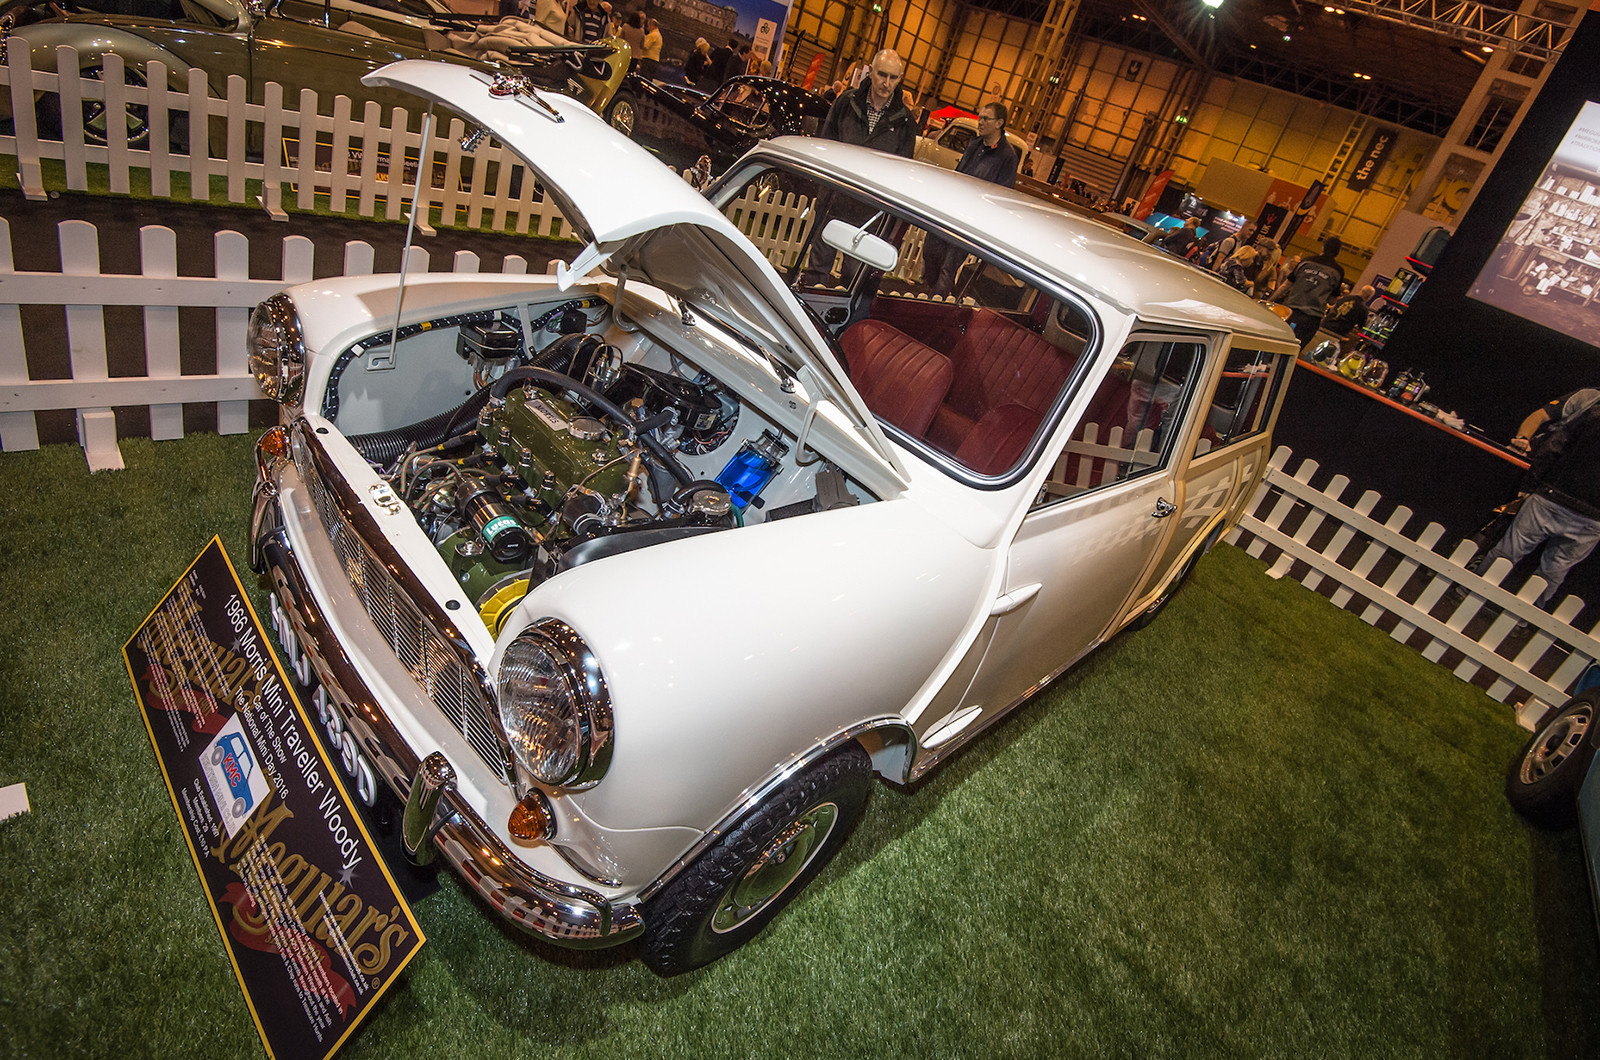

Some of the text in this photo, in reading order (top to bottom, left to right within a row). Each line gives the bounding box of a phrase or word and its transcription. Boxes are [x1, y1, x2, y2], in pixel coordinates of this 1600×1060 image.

[1356, 135, 1388, 180] the nec
[535, 405, 560, 424] MORRIS
[486, 519, 517, 536] Lucas
[222, 590, 362, 872] 1966 Morris Mini Traveller Woody
[233, 685, 289, 801] The National Mini Day 2016
[251, 692, 289, 766] Car of The Show
[312, 684, 378, 807] 439D
[192, 776, 201, 793] Club
[221, 751, 242, 789] KMC
[180, 786, 196, 822] Membership
[214, 787, 227, 811] MINI
[221, 805, 237, 836] CLUB
[285, 964, 295, 982] Chip
[292, 977, 300, 993] runs
[301, 996, 315, 1026] Treasure
[312, 1022, 323, 1044] Hunts
[298, 973, 314, 1008] throughout
[311, 1004, 319, 1017] the
[315, 1014, 325, 1031] year
